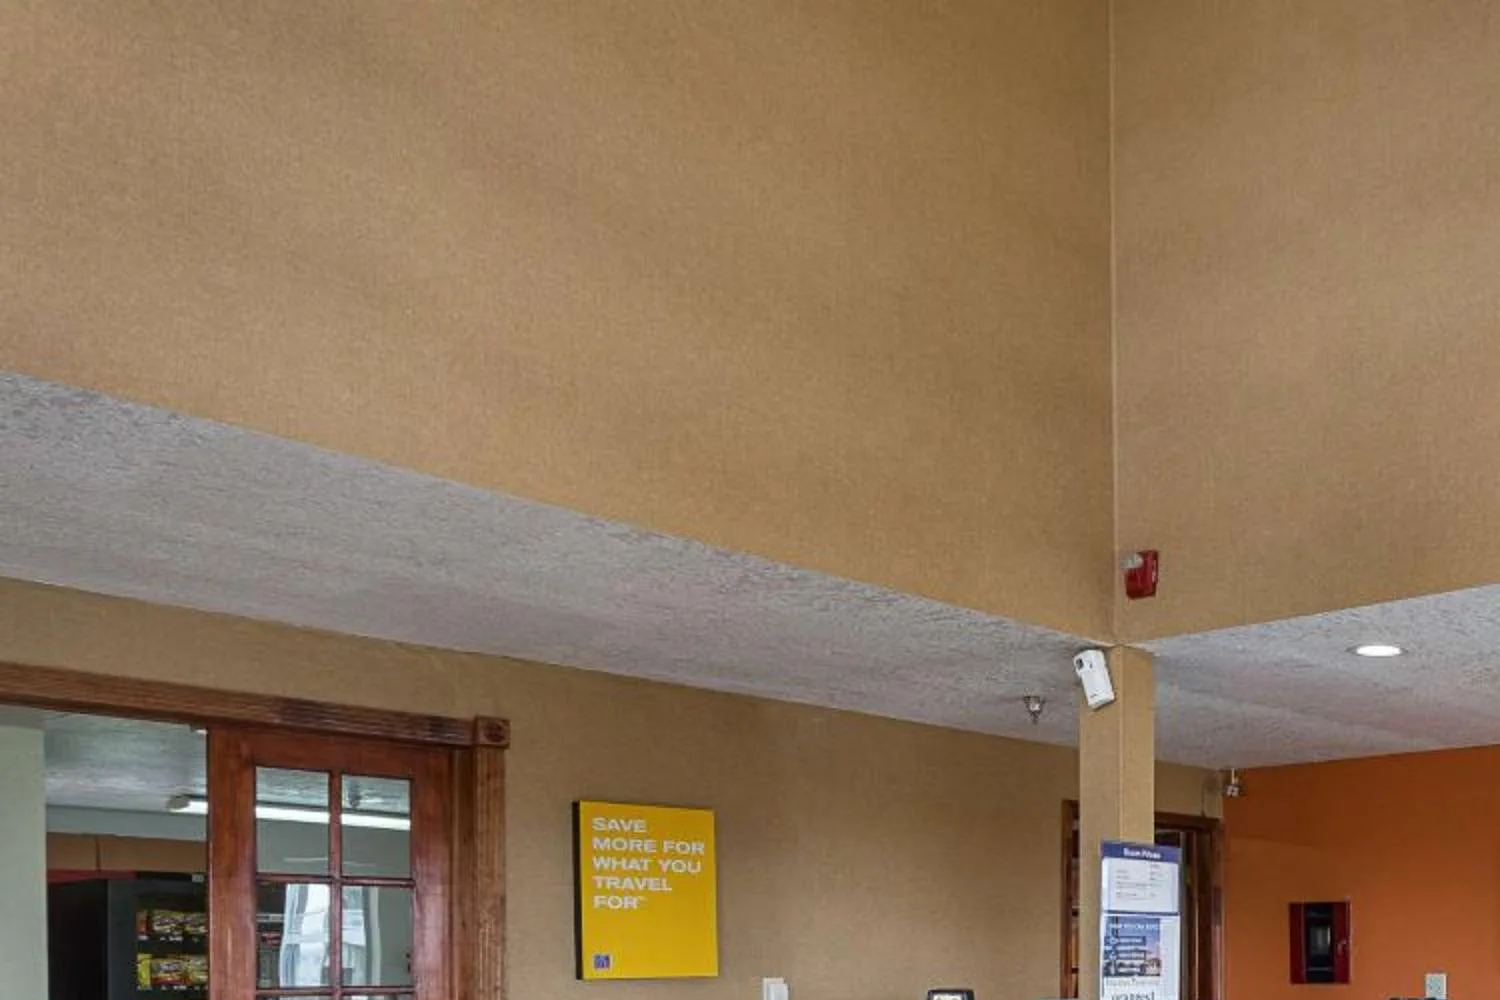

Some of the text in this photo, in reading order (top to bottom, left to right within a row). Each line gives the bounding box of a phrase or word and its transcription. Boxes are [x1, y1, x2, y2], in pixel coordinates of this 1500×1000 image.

[592, 817, 648, 833] SAVE
[592, 837, 705, 856] MORE FOR
[592, 856, 702, 873] WHAT YOU
[592, 875, 673, 891] TRAVEL
